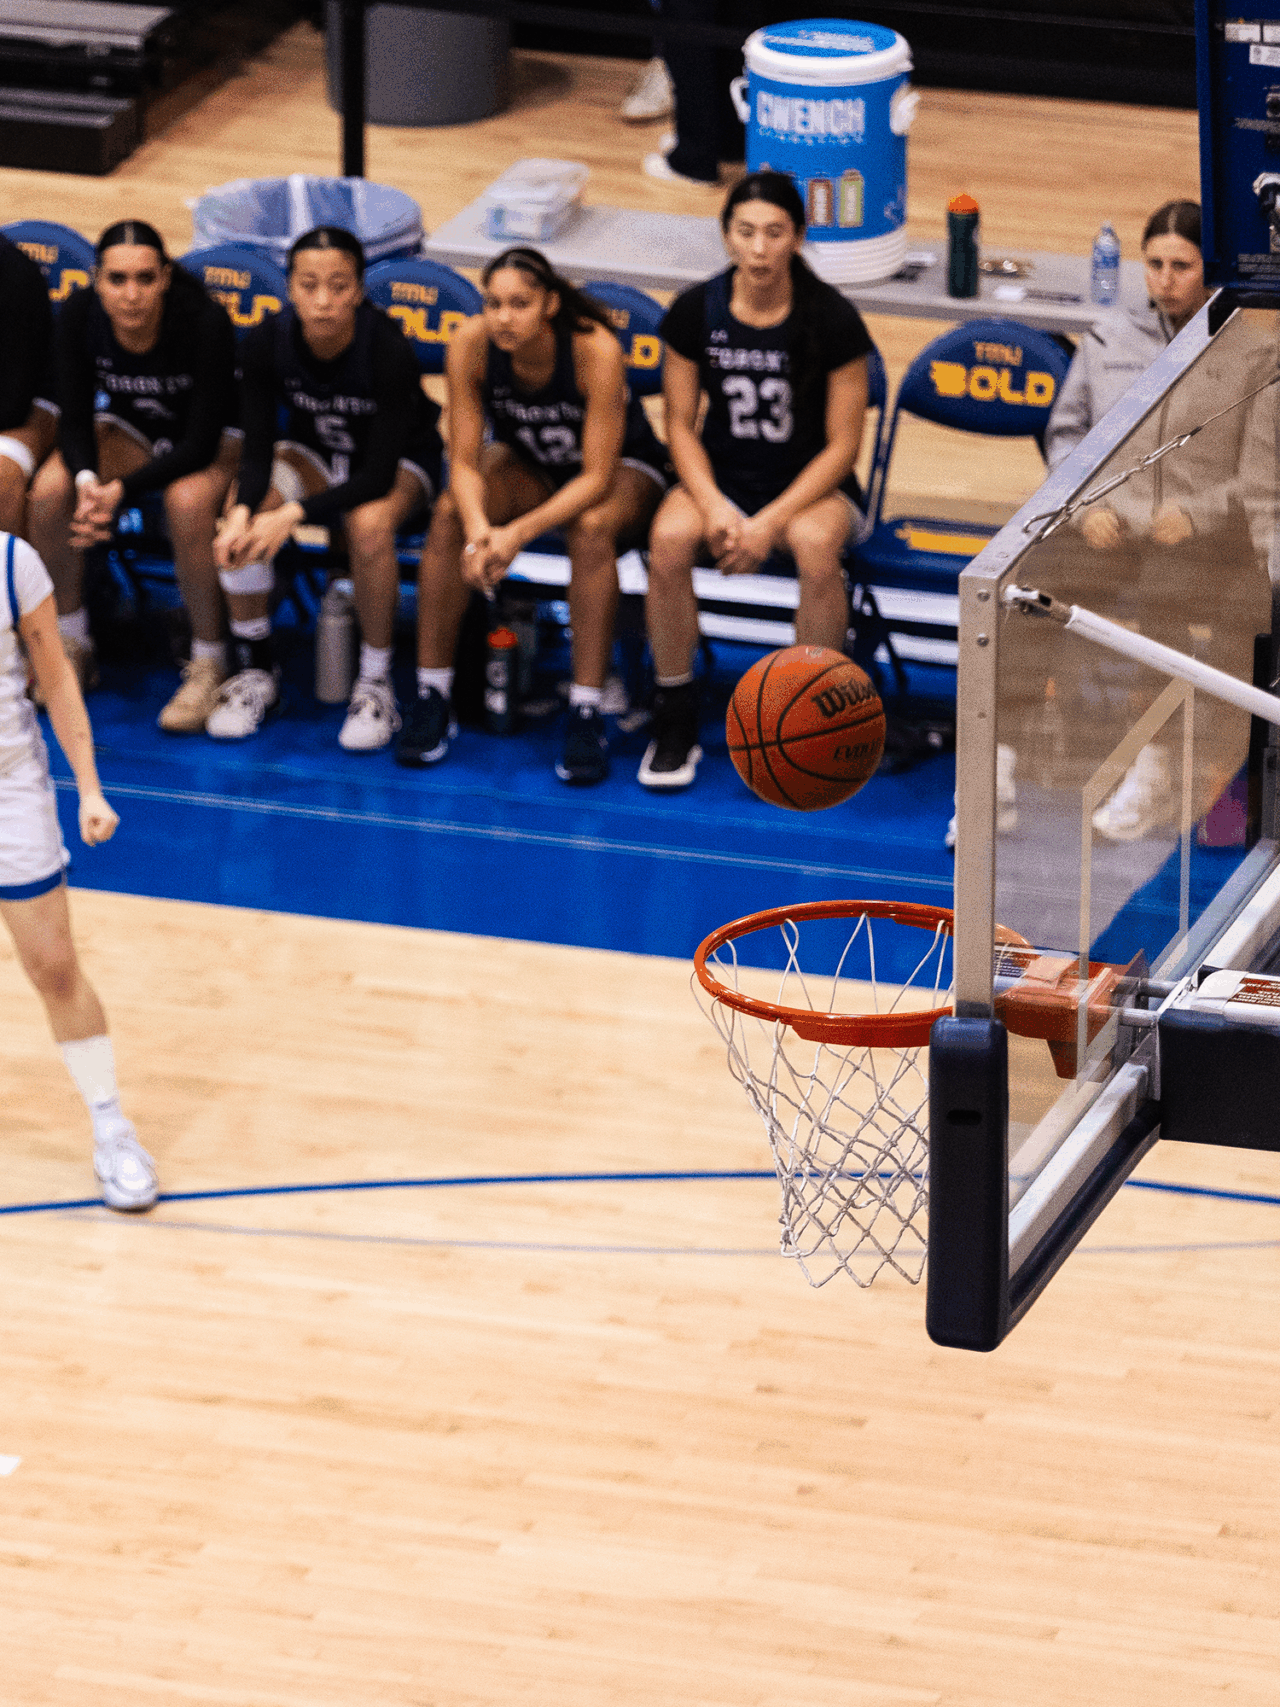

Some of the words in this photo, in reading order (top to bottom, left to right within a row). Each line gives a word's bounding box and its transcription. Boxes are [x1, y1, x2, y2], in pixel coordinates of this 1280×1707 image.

[387, 304, 467, 344] OLD
[974, 341, 1023, 366] TMU
[721, 374, 793, 443] 23
[517, 425, 583, 466] 12
